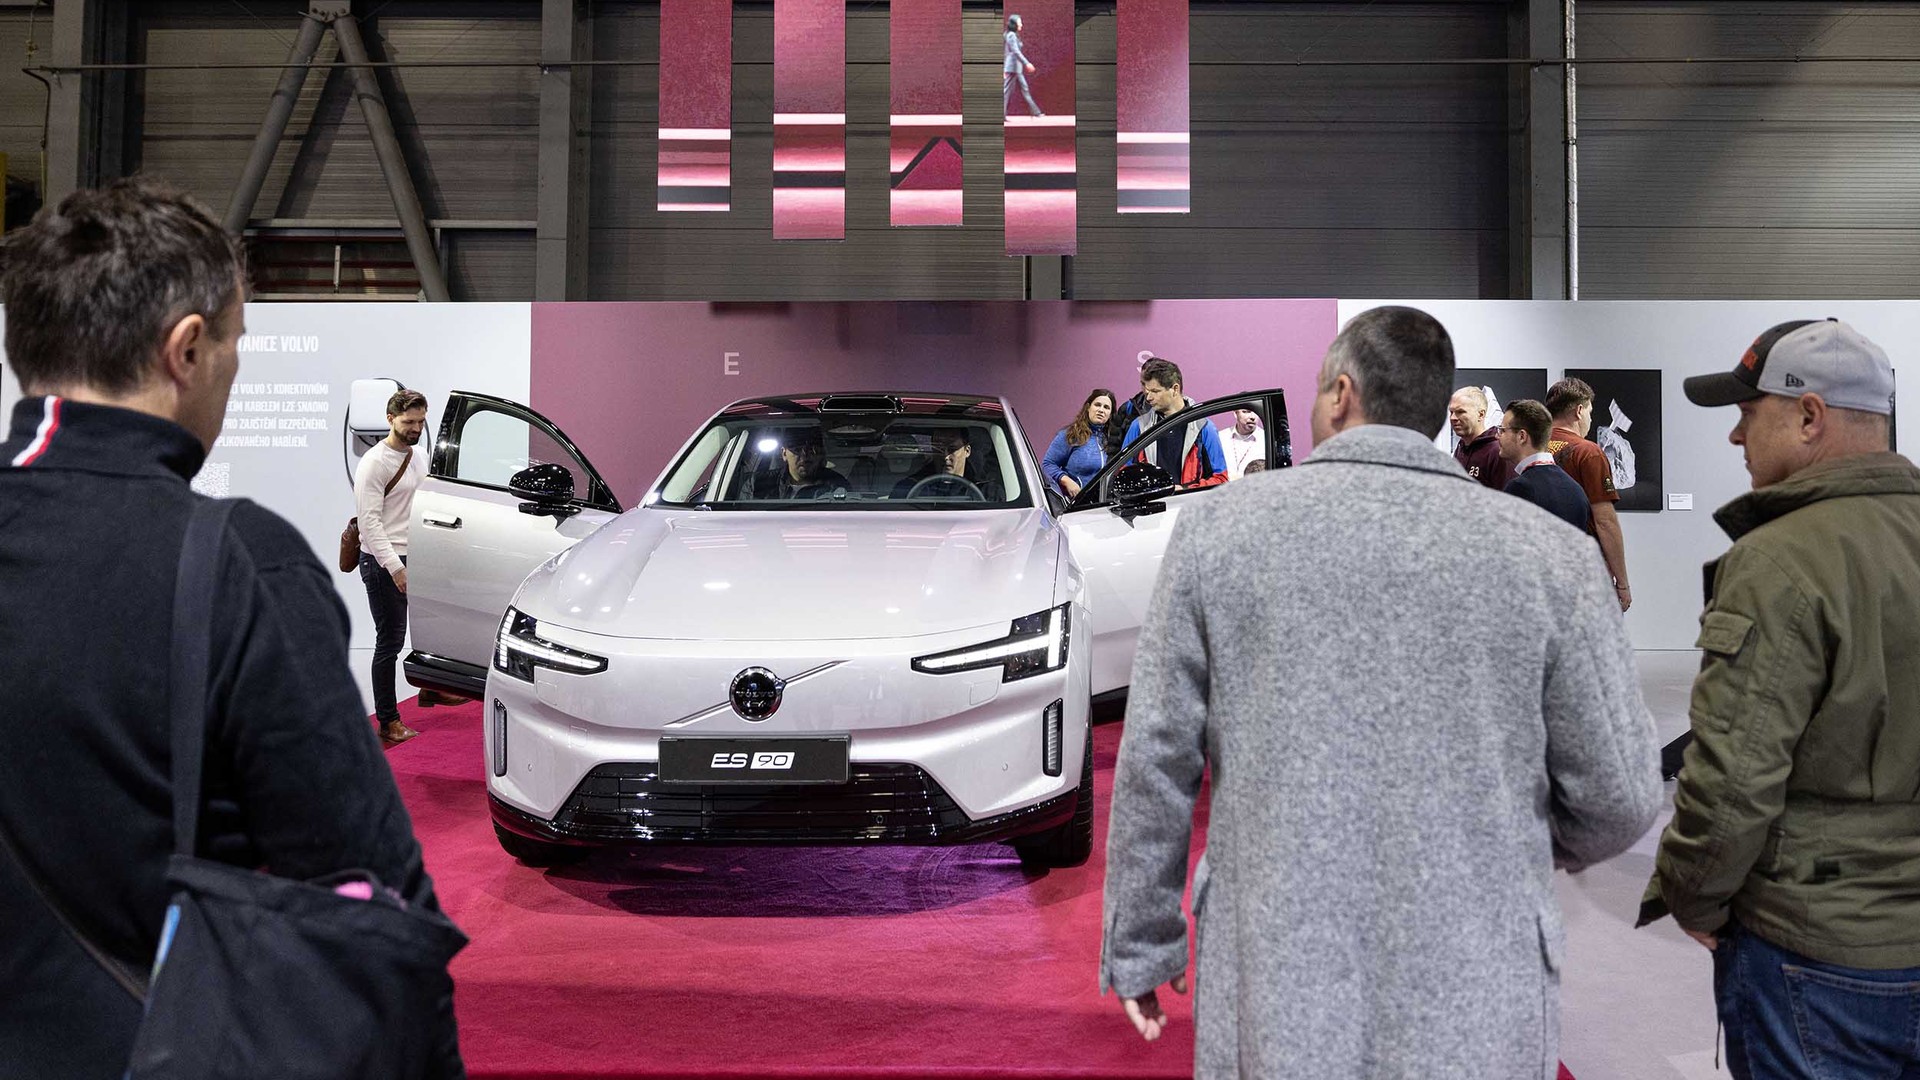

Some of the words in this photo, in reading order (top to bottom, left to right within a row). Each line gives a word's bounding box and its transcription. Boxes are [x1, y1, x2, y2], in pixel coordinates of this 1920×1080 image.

[280, 335, 319, 352] VOLVO
[725, 352, 739, 375] E
[240, 383, 265, 394] VOLVO
[266, 383, 272, 394] S
[244, 401, 280, 412] KABELEM
[282, 401, 296, 412] LZE
[297, 401, 329, 412] SNADNO
[1469, 465, 1480, 477] 23
[710, 752, 749, 768] ES
[757, 754, 790, 767] 90
